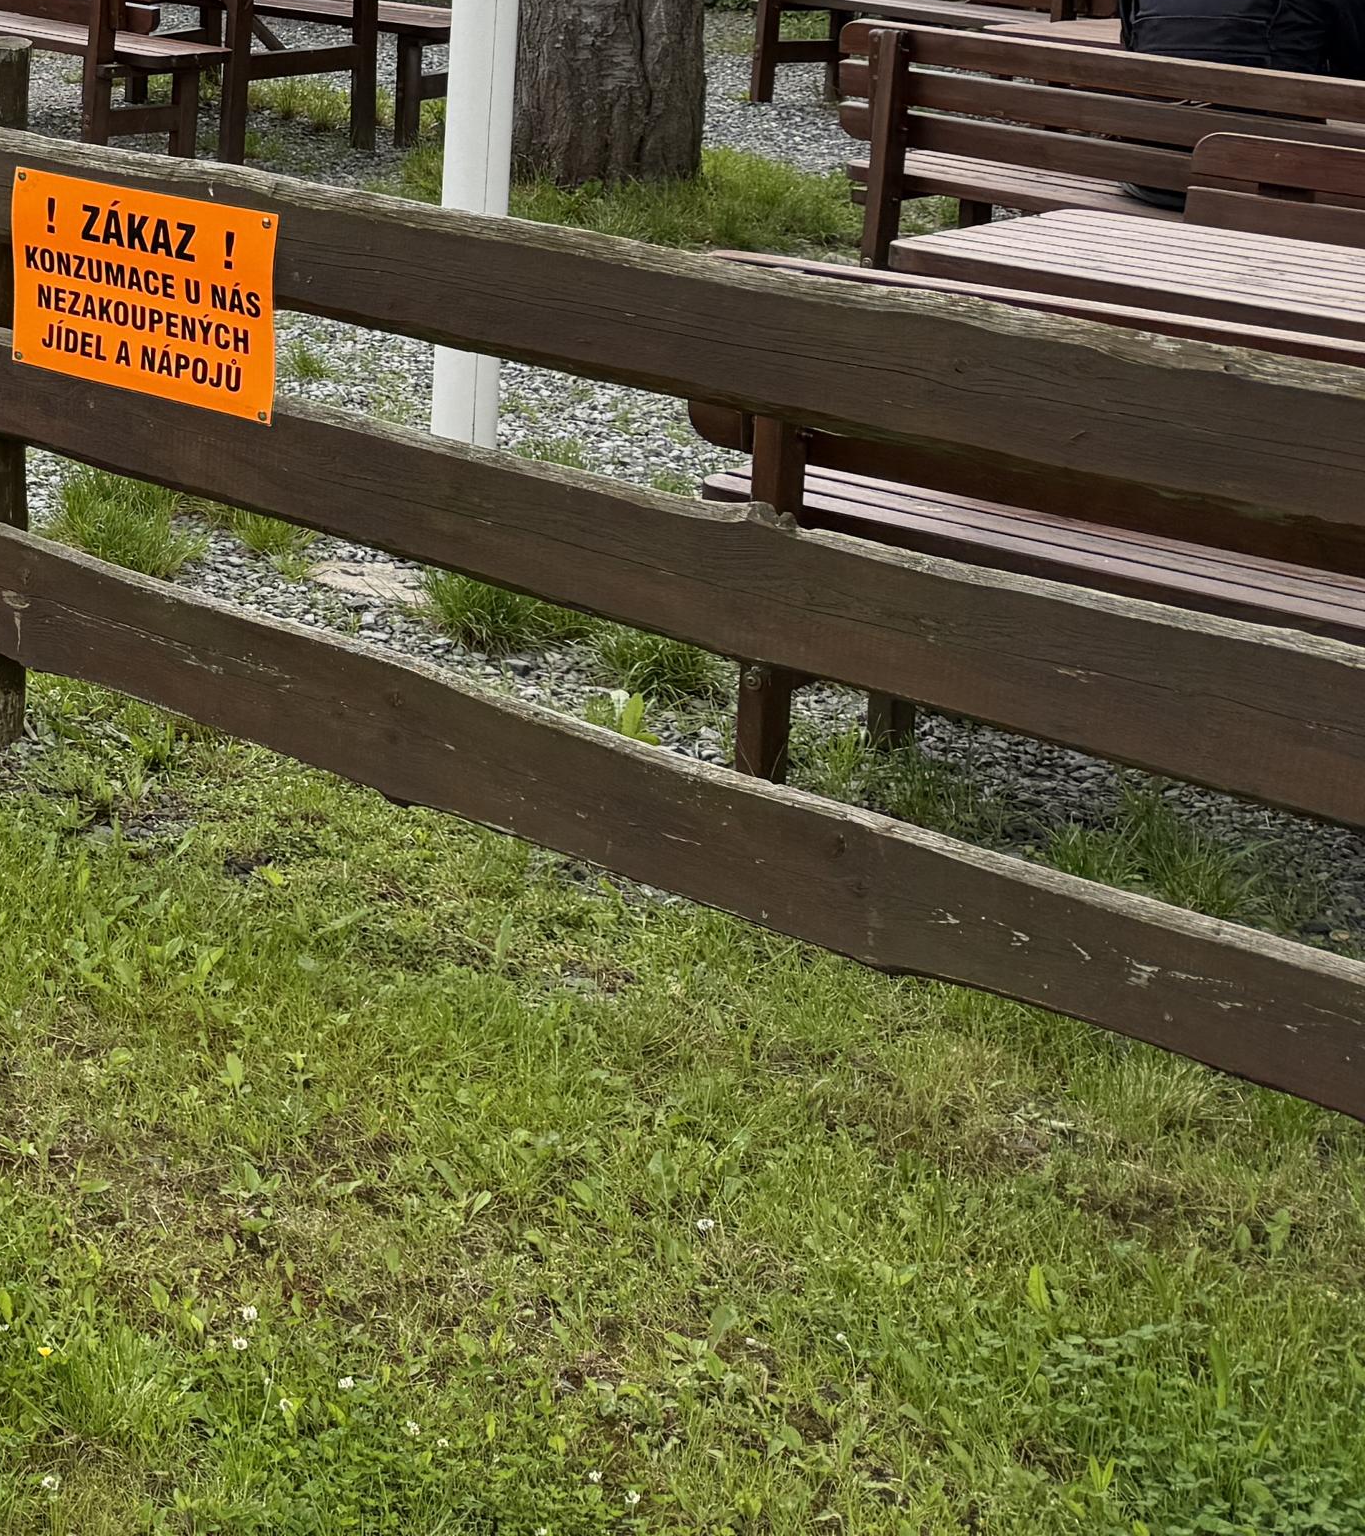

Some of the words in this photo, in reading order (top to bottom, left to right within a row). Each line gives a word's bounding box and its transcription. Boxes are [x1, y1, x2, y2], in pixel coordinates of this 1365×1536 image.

[81, 200, 196, 263] ZÁKAZ
[24, 245, 175, 299] KONZUMACE
[185, 278, 200, 305] U
[211, 282, 261, 318] NÁS
[37, 283, 250, 354] NEZAKOUPENÝCH
[41, 320, 107, 362] JÍDEL
[115, 340, 131, 367] A
[140, 344, 242, 392] NÁPOJŮ
